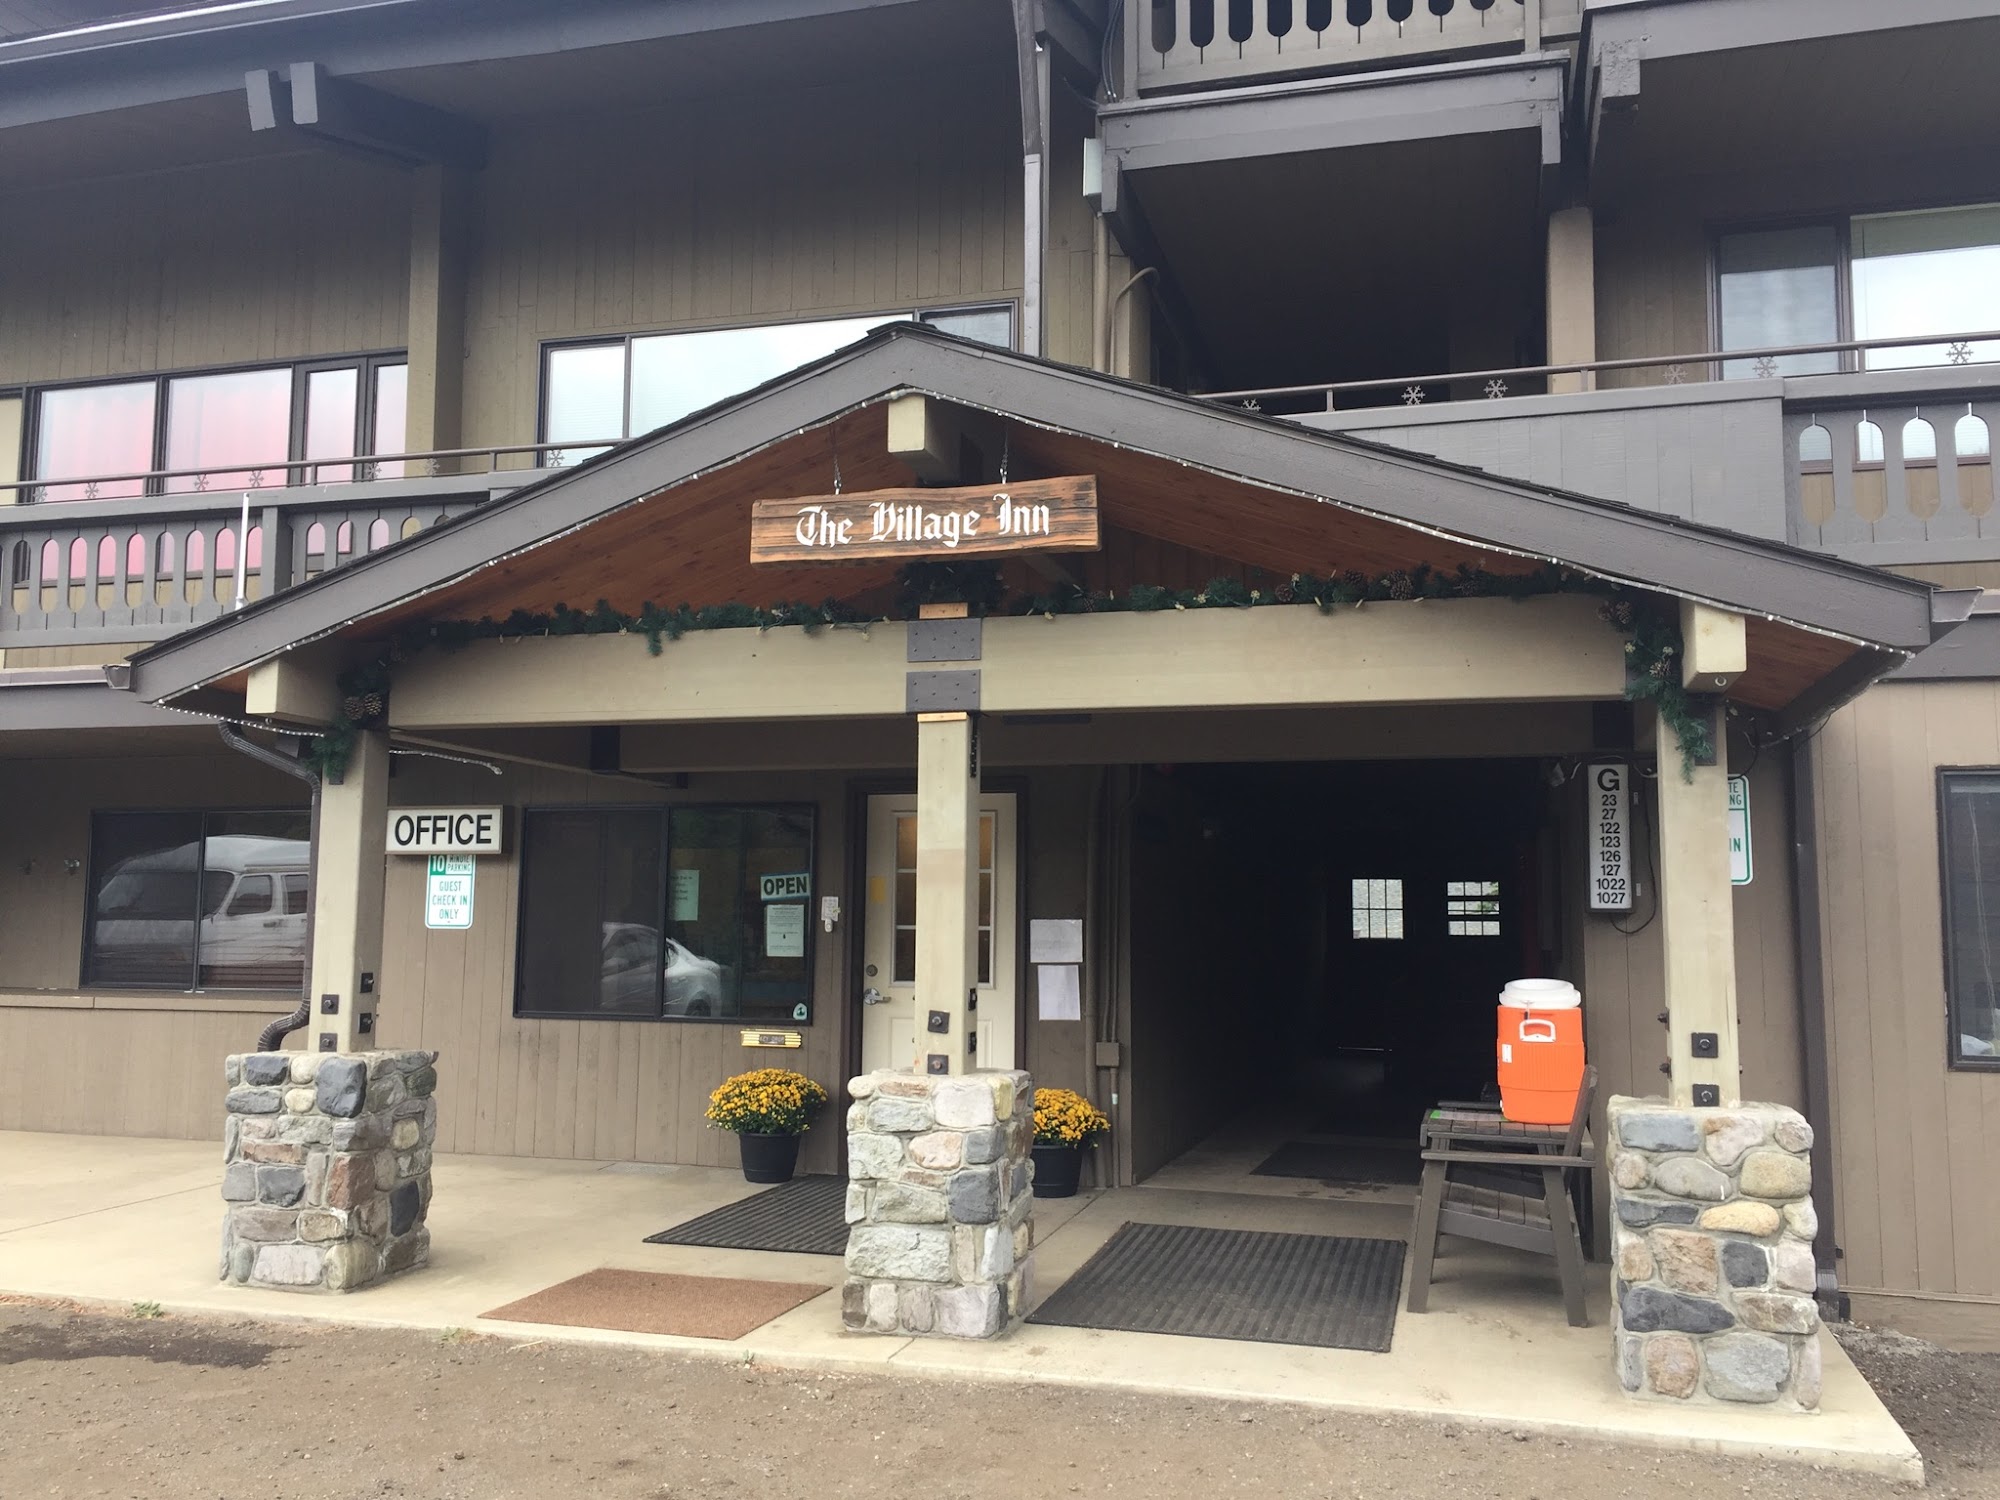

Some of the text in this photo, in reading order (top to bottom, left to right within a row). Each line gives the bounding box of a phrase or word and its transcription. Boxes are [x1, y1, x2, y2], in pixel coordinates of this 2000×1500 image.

[796, 493, 1050, 548] The Village Inn
[1597, 768, 1620, 791] G
[1601, 794, 1617, 806] 23
[1602, 808, 1617, 820] 27
[395, 814, 492, 846] OFFICE
[1600, 822, 1620, 834] 122
[1600, 836, 1621, 848] 123
[1600, 850, 1621, 862] 126
[432, 855, 445, 872] 10
[447, 863, 471, 872] PARKING
[1601, 865, 1620, 876] 127
[439, 881, 462, 892] GUEST
[763, 876, 807, 895] OPEN
[1596, 878, 1626, 890] 1022
[432, 895, 468, 906] CHECK IN
[1596, 892, 1626, 904] 1027
[439, 909, 459, 919] ONLY
